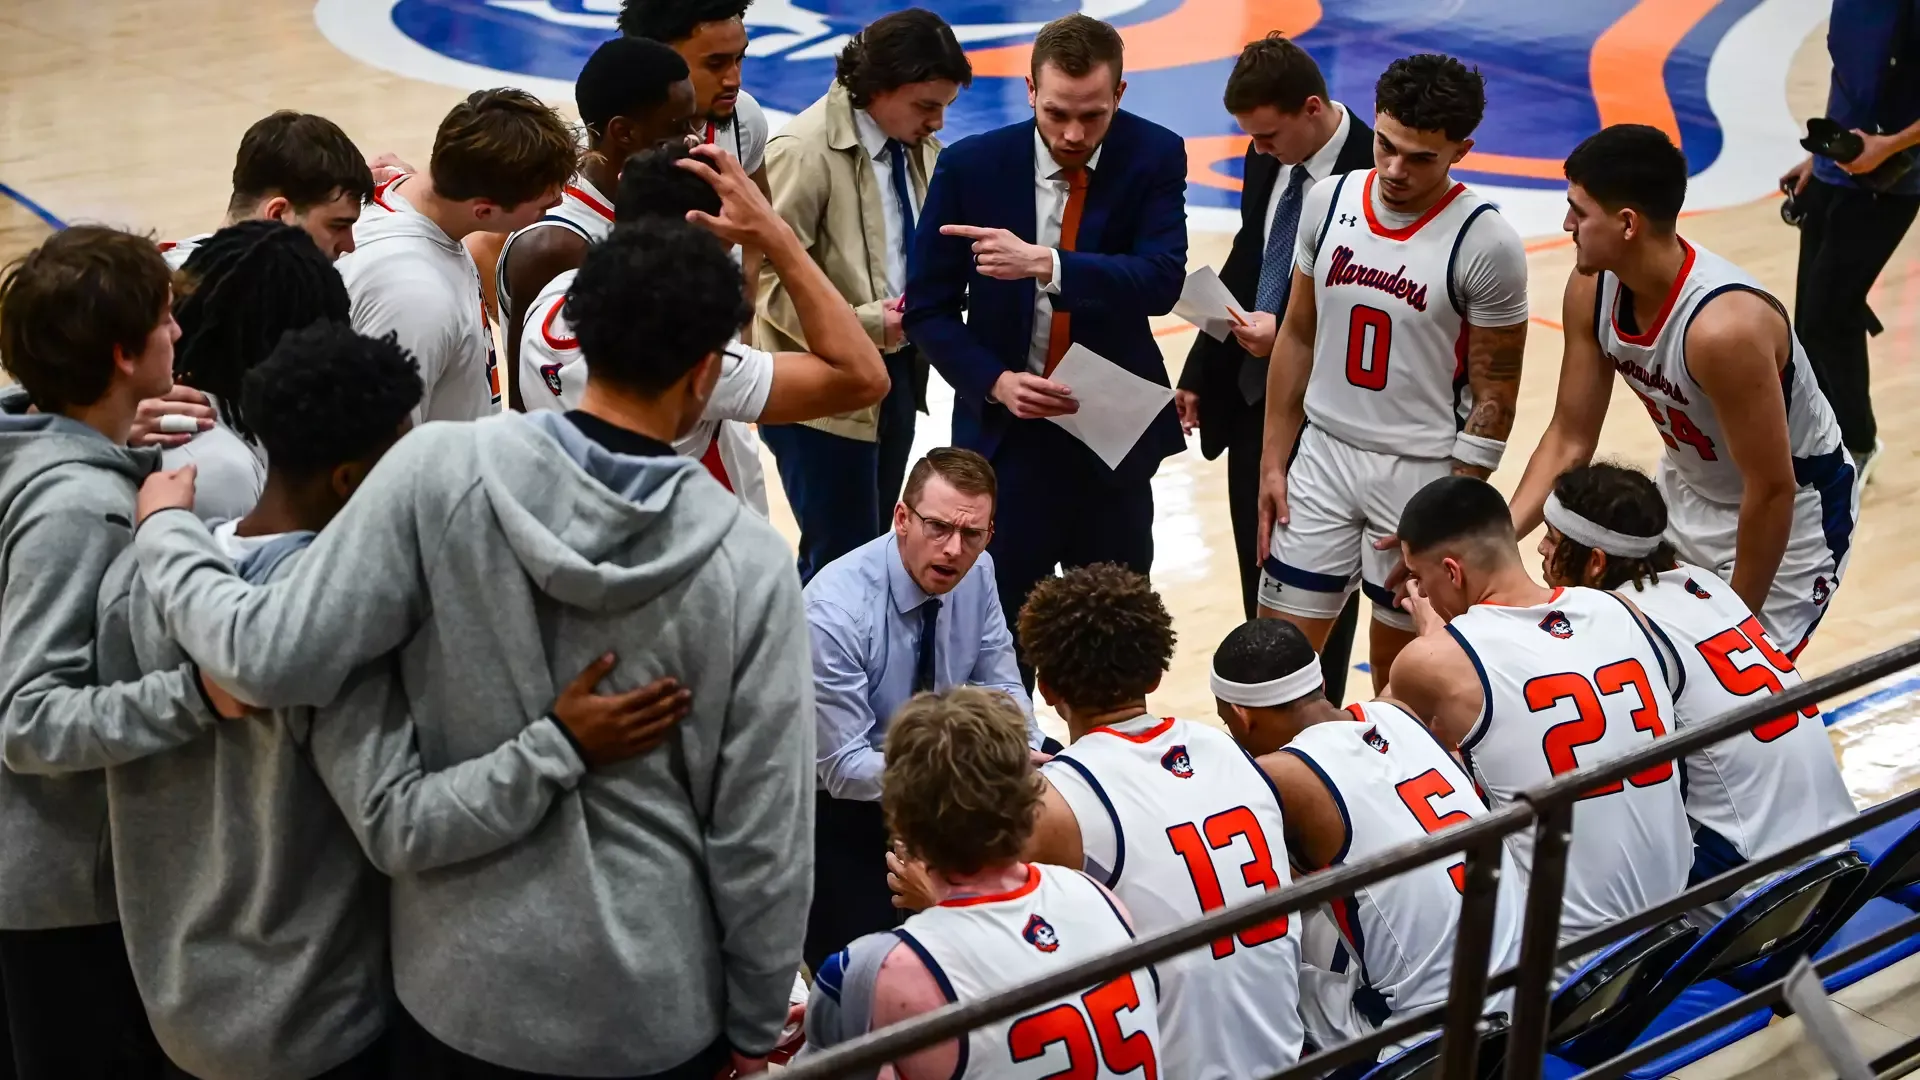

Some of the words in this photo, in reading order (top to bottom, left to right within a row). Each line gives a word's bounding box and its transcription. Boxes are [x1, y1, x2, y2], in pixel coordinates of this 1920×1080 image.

[1325, 245, 1428, 312] Marauders
[1345, 303, 1392, 391] 0
[1523, 657, 1673, 802] 23
[1695, 614, 1820, 743] 55
[1165, 805, 1289, 960] 13
[1008, 972, 1158, 1080] 25
